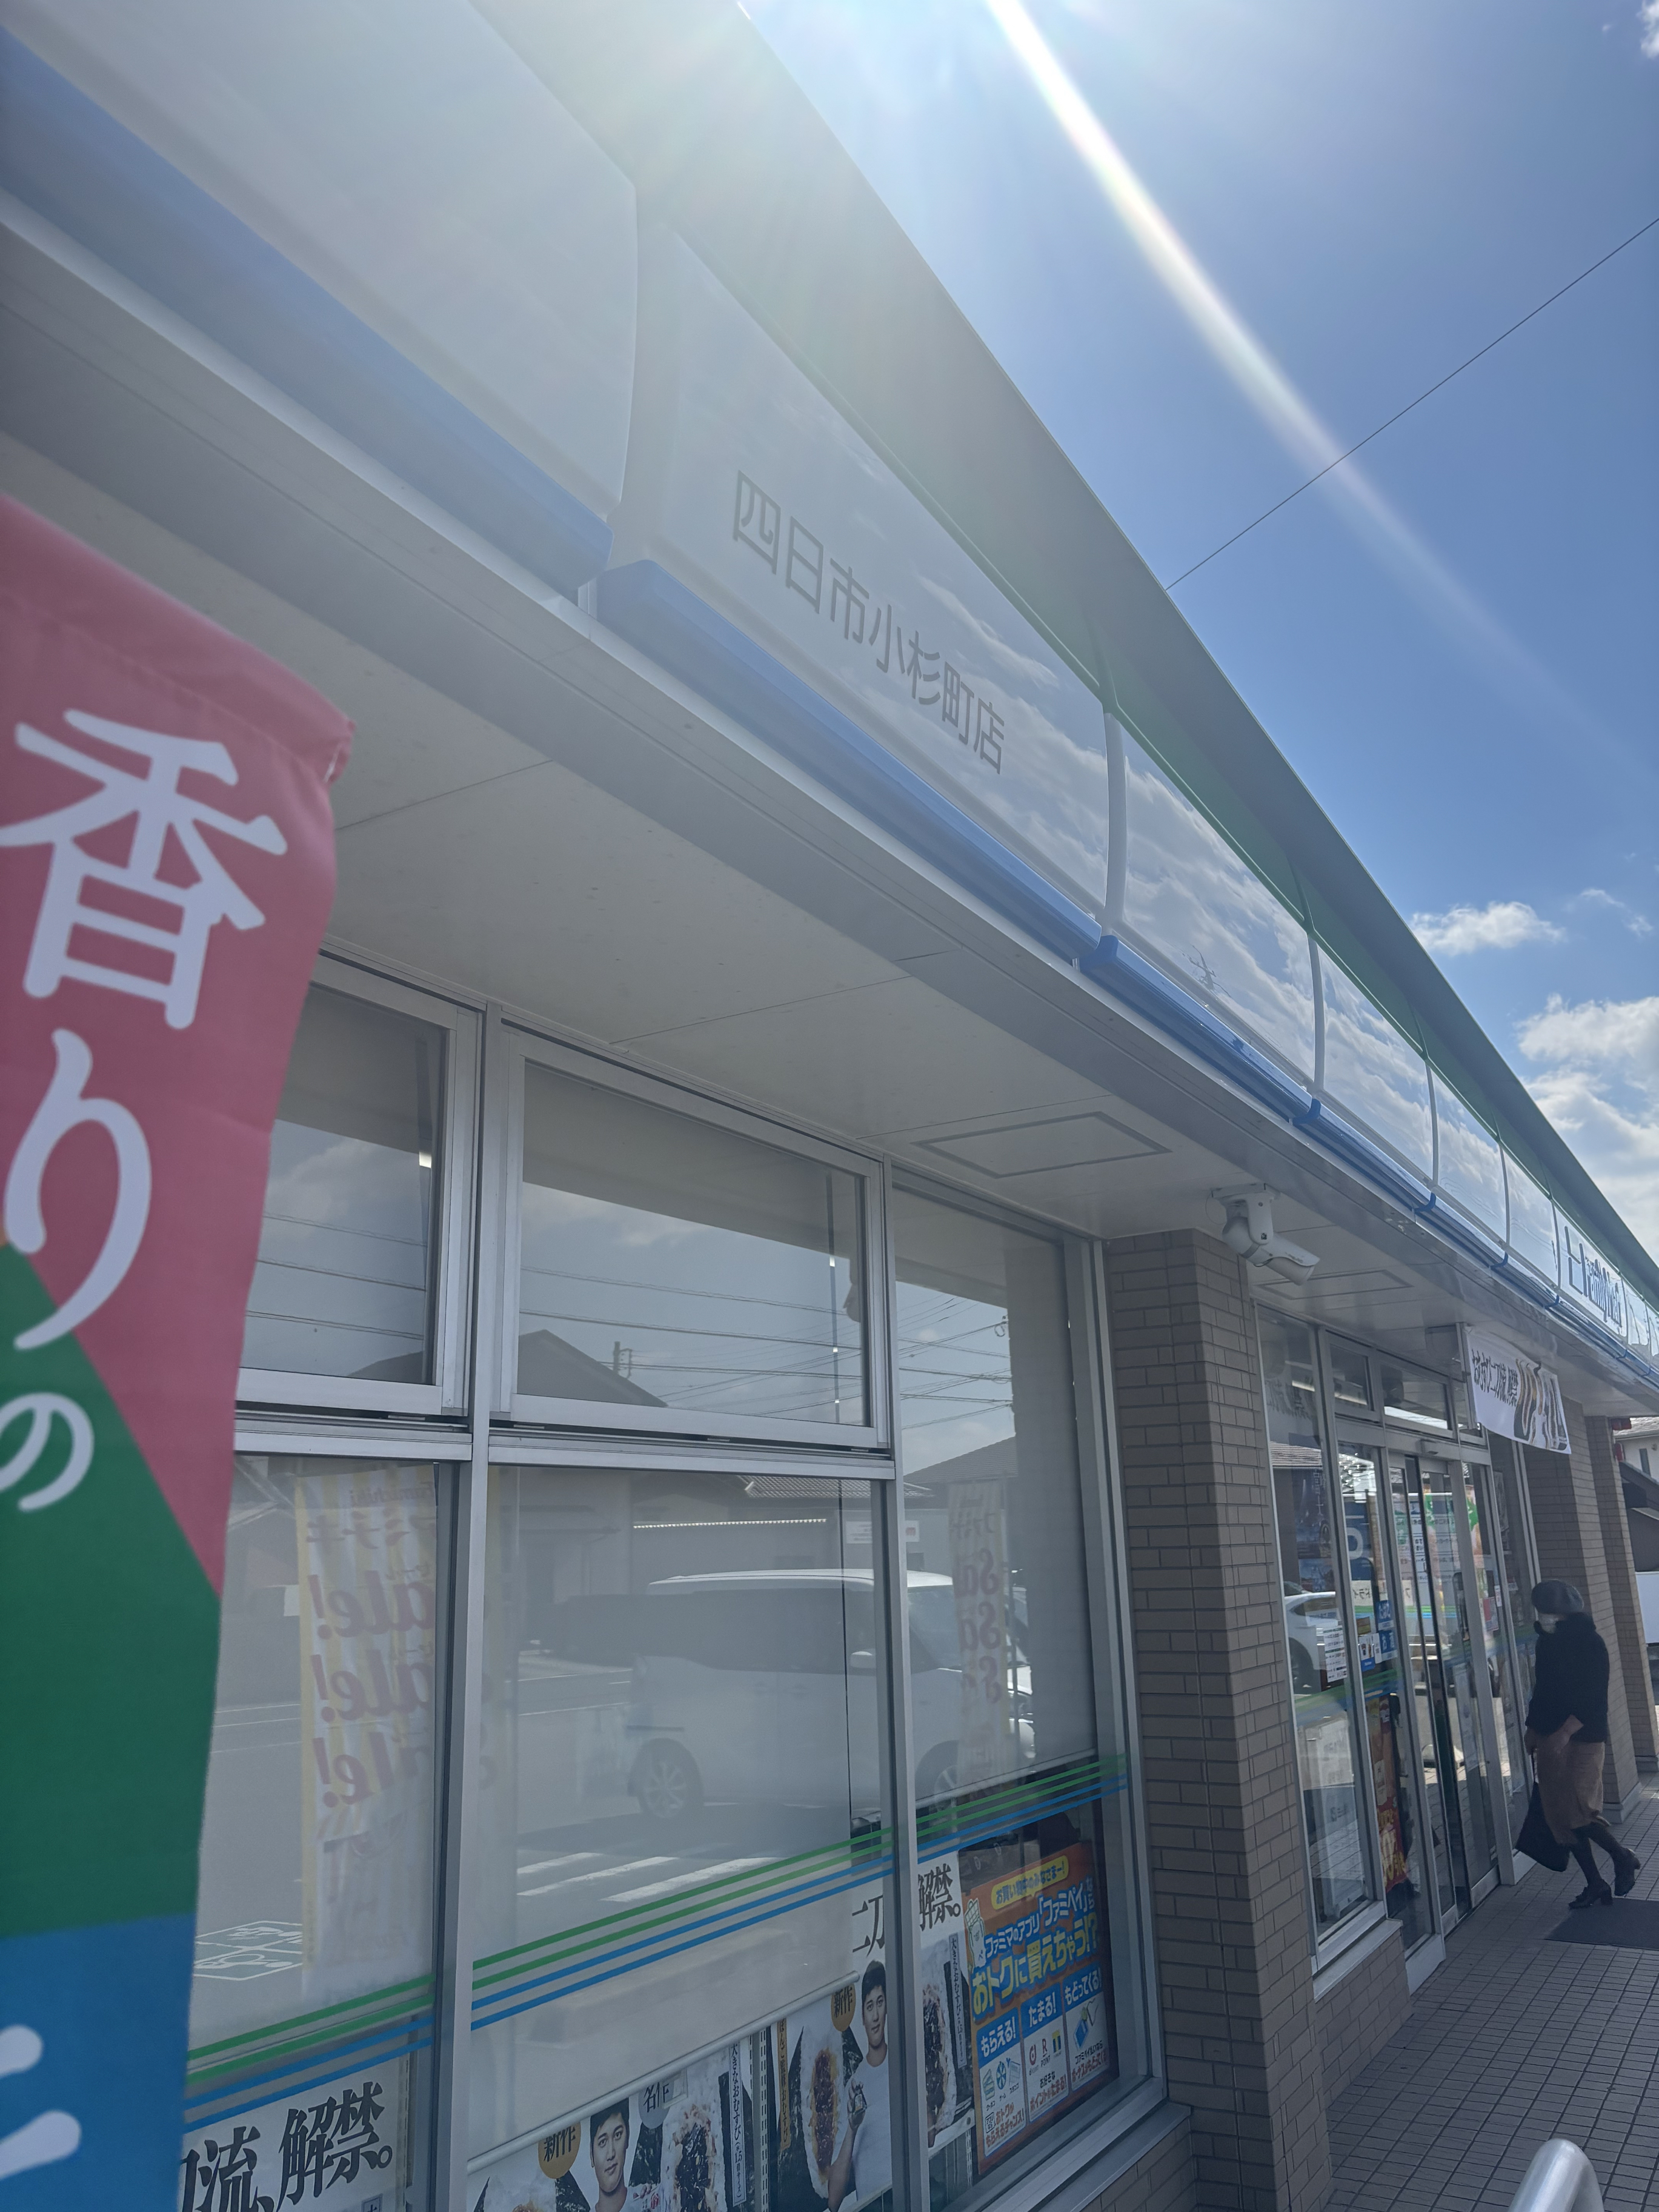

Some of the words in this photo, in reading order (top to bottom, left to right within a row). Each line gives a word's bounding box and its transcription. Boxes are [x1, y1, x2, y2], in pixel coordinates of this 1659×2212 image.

[733, 470, 1005, 775] 四日市小杉町店
[918, 1863, 961, 1931] 解禁。
[834, 1986, 853, 2018] 新作
[1065, 1968, 1102, 2006] もどってくる!
[1028, 1991, 1057, 2028] たまる!
[981, 2016, 1016, 2058] もらえる!
